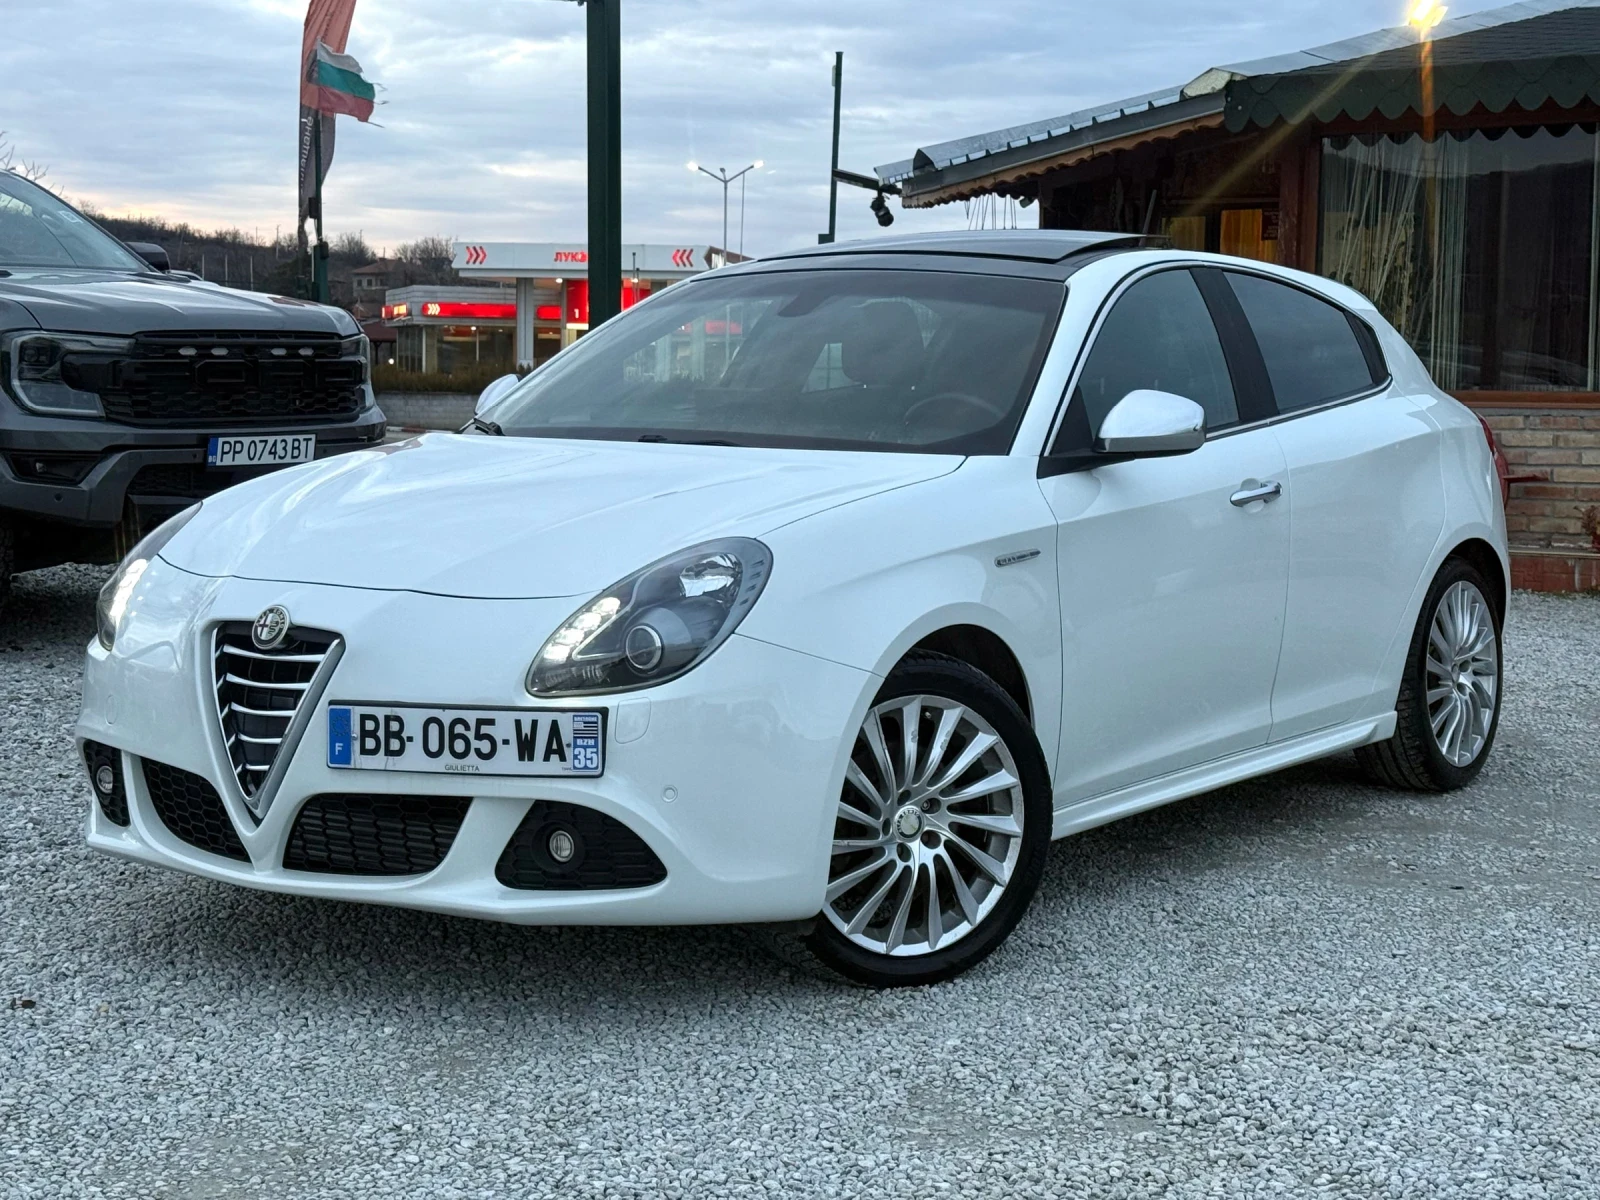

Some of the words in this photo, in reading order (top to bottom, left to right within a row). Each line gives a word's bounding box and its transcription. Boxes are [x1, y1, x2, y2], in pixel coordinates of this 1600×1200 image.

[359, 713, 567, 763] BB-065-WA
[335, 743, 343, 755] F
[573, 747, 598, 768] 35
[444, 764, 480, 773] GIULIETTA
